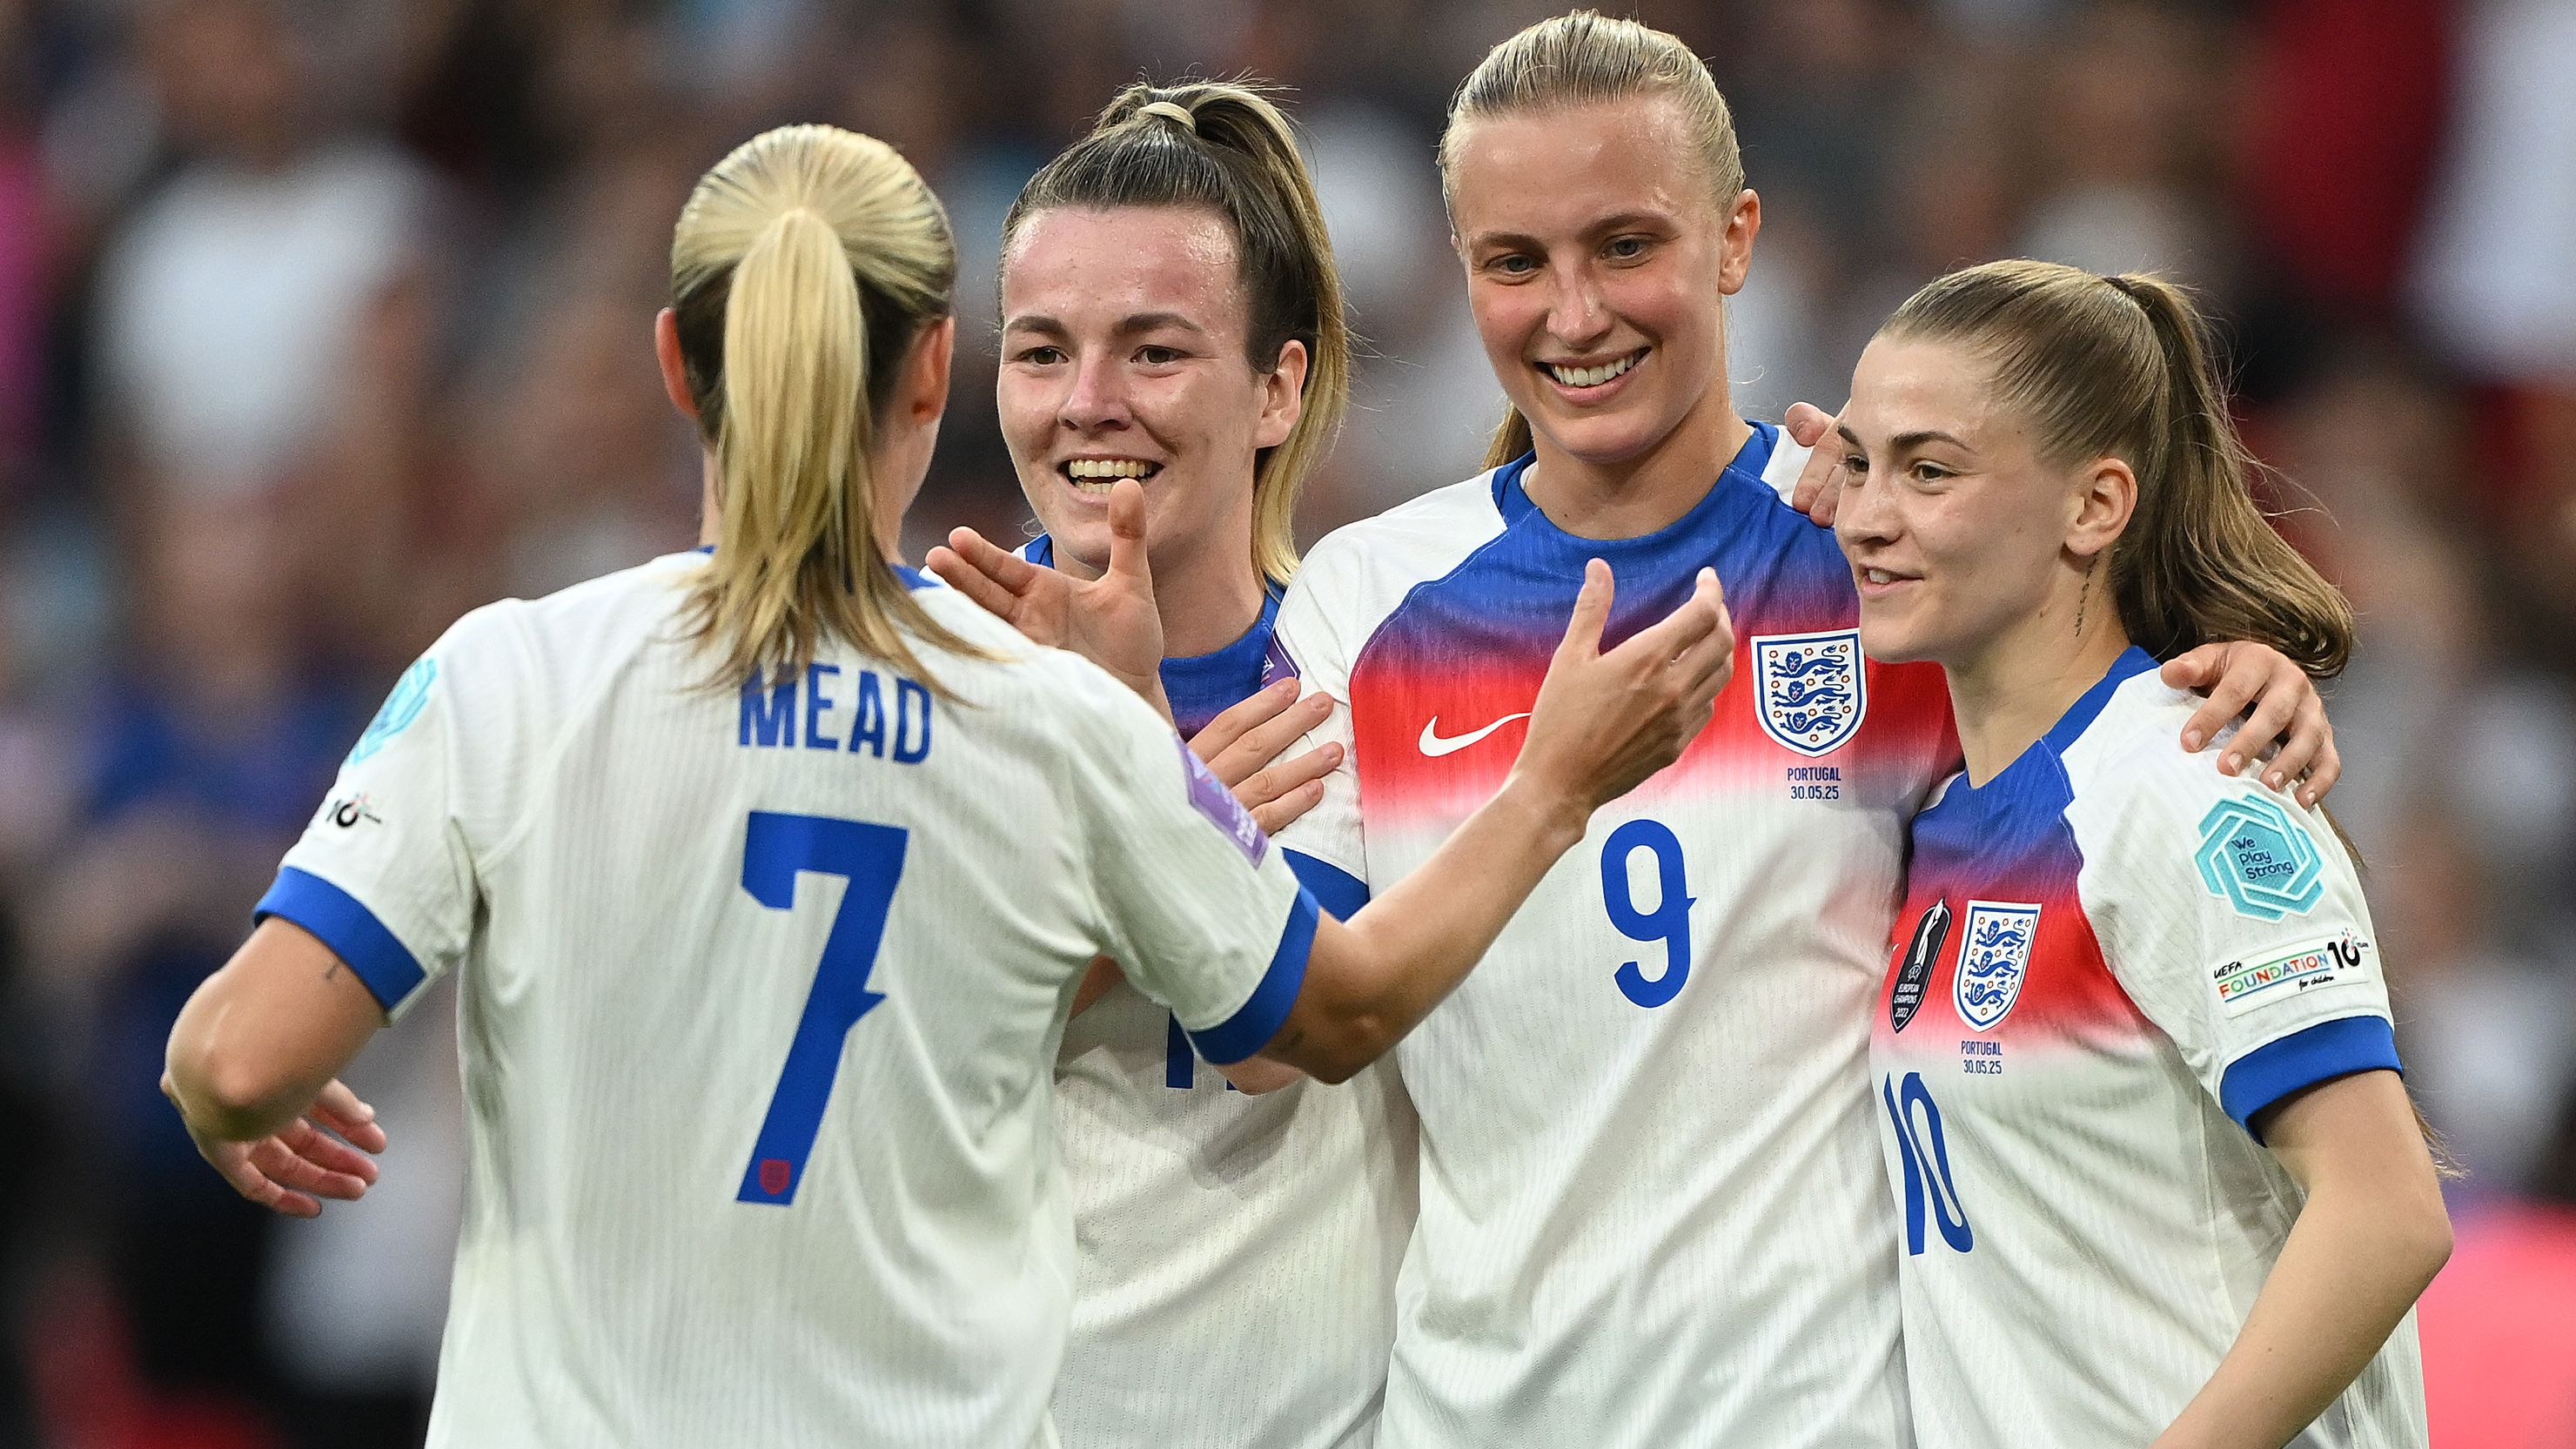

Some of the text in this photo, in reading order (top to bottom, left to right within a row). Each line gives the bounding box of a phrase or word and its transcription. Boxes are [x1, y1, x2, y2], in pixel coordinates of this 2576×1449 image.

[739, 661, 932, 764] MEAD
[1787, 767, 1841, 782] PORTUGAL
[1790, 786, 1839, 800] 30.05.25
[2231, 836, 2256, 850] We
[2238, 849, 2272, 866] Play
[2244, 861, 2294, 880] Strong
[1600, 819, 1697, 1009] 9
[2327, 939, 2361, 969] 10
[2213, 961, 2243, 979] UEFA
[2219, 953, 2330, 998] FOUNDATION
[735, 810, 909, 1206] 7
[1961, 1040, 2002, 1056] PORTUGAL
[1963, 1059, 2002, 1075] 30.05.25
[1883, 1070, 1974, 1257] 10
